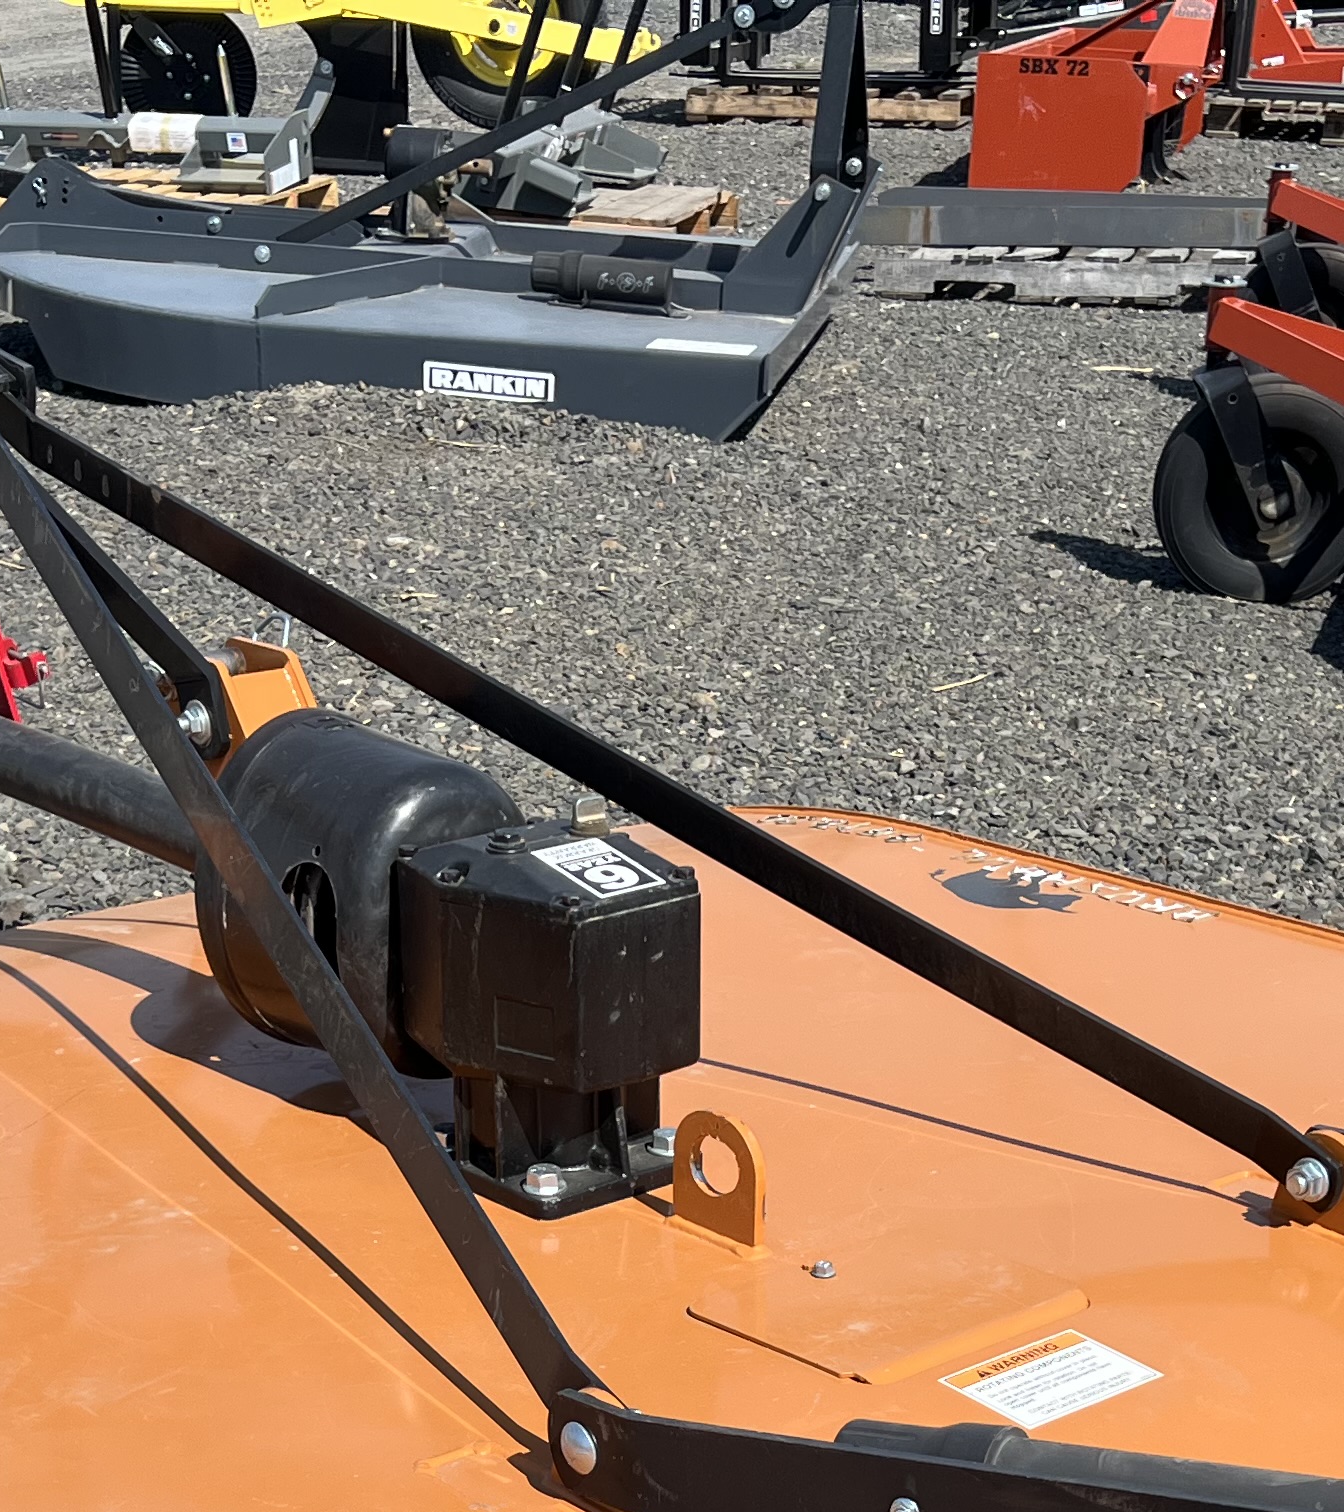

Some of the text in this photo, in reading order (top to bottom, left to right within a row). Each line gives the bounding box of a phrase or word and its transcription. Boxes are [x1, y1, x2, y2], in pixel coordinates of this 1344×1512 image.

[1019, 58, 1089, 76] SBX 72
[431, 367, 546, 399] RANKIN
[583, 864, 640, 890] 6
[976, 1346, 1093, 1393] ROTATING COMPONENTS
[989, 1342, 1060, 1373] WARNING
